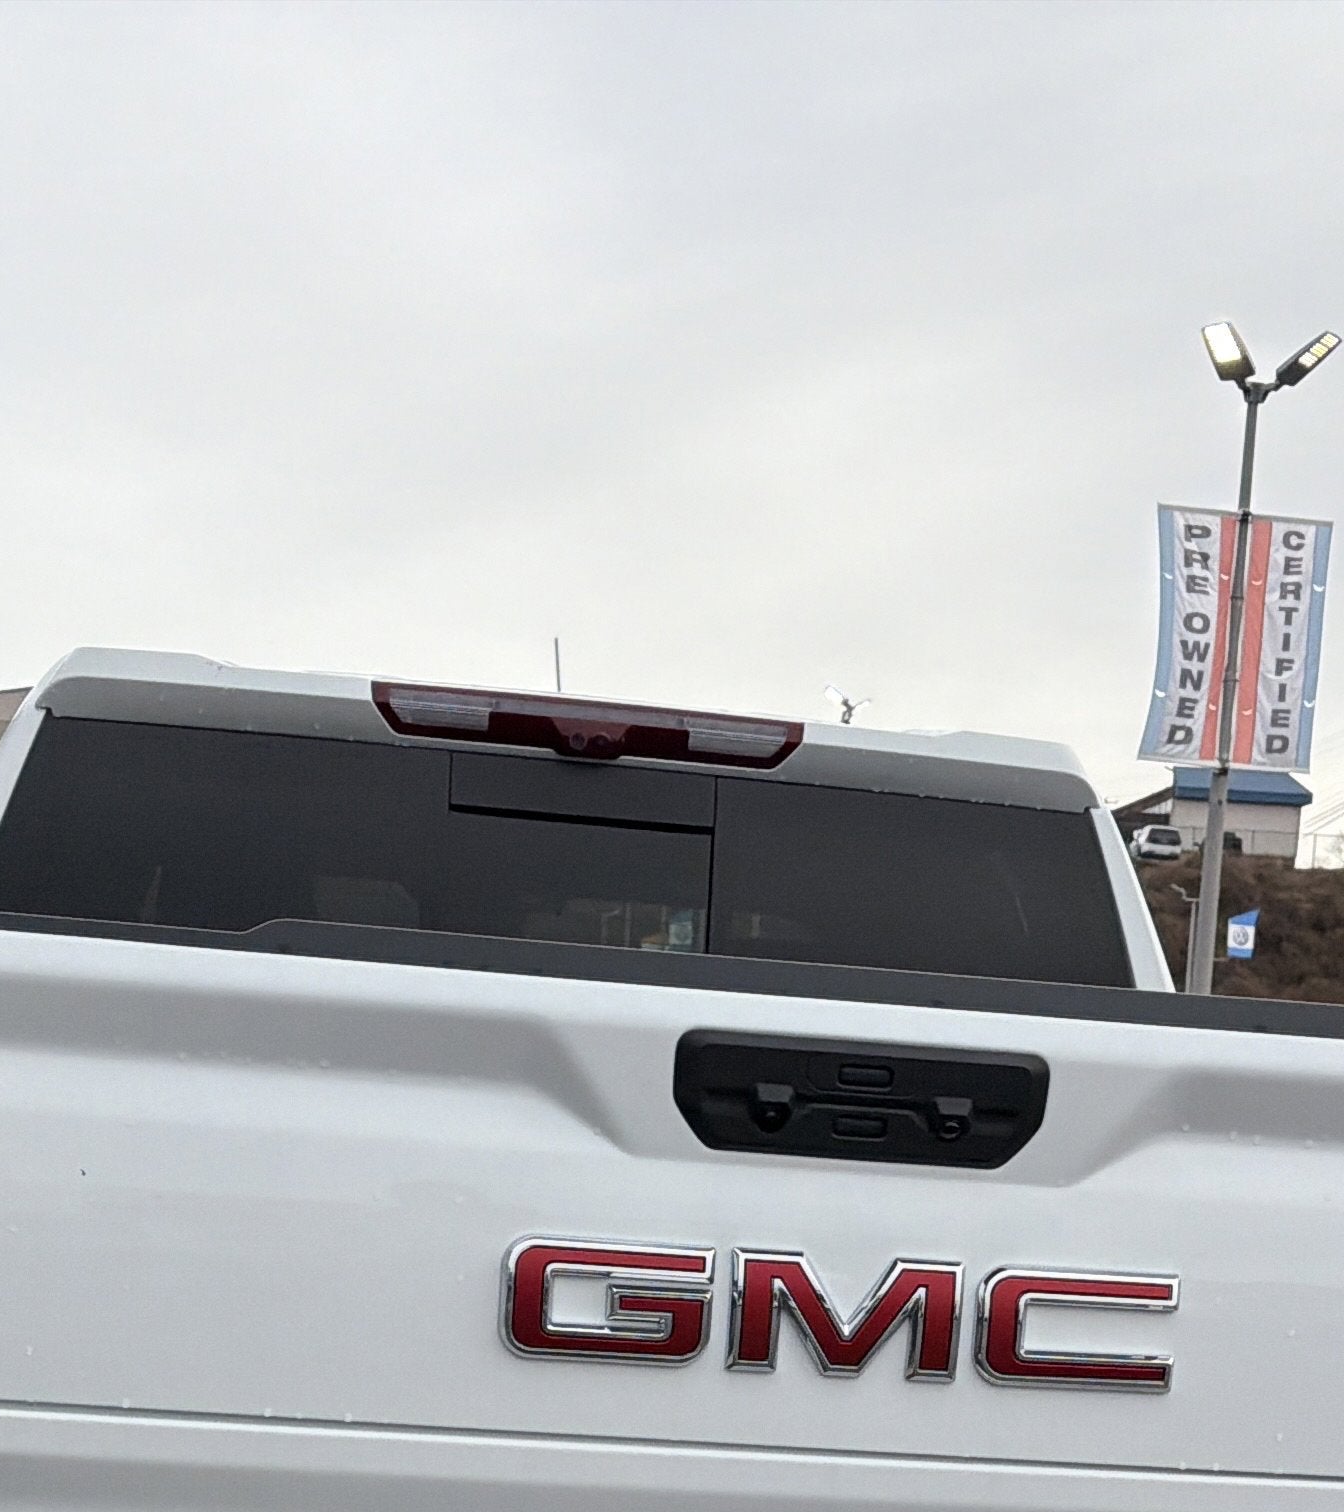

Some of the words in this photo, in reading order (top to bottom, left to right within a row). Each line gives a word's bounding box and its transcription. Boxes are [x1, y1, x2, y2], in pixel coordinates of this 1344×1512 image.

[1183, 524, 1212, 596] PRE
[1165, 612, 1211, 746] OWNED
[1265, 530, 1306, 754] CERTIFIED
[500, 1235, 1181, 1393] GMC
